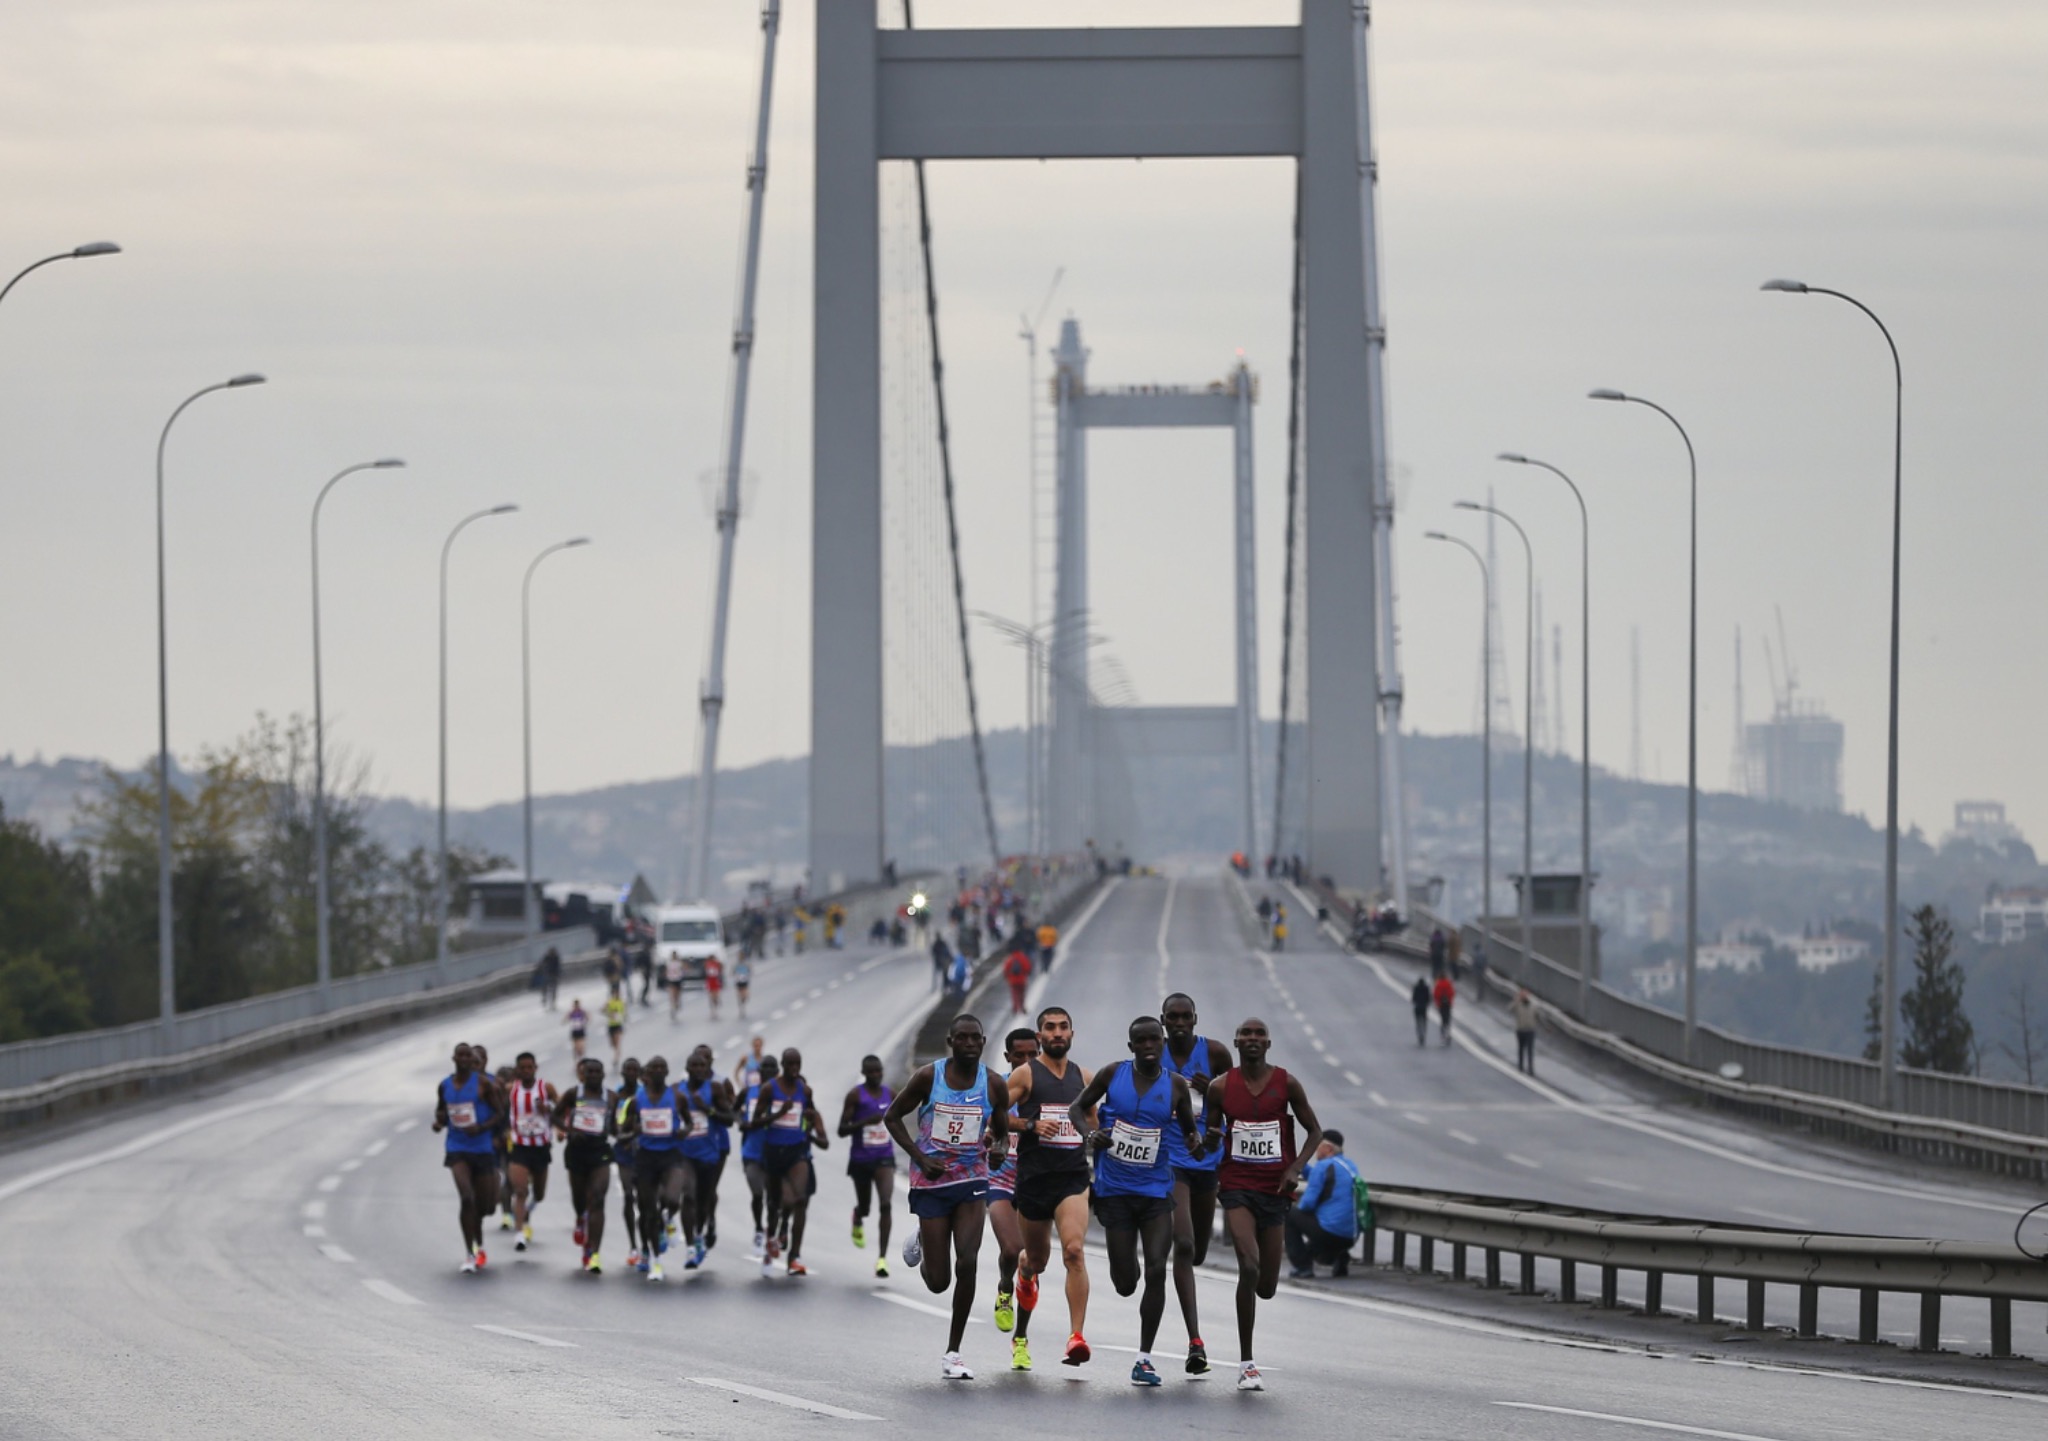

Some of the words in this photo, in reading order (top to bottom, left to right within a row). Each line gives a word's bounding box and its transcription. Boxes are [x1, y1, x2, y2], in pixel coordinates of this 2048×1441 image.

[948, 1121, 964, 1135] 52
[1116, 1141, 1151, 1160] PACE
[1241, 1140, 1274, 1156] PACE
